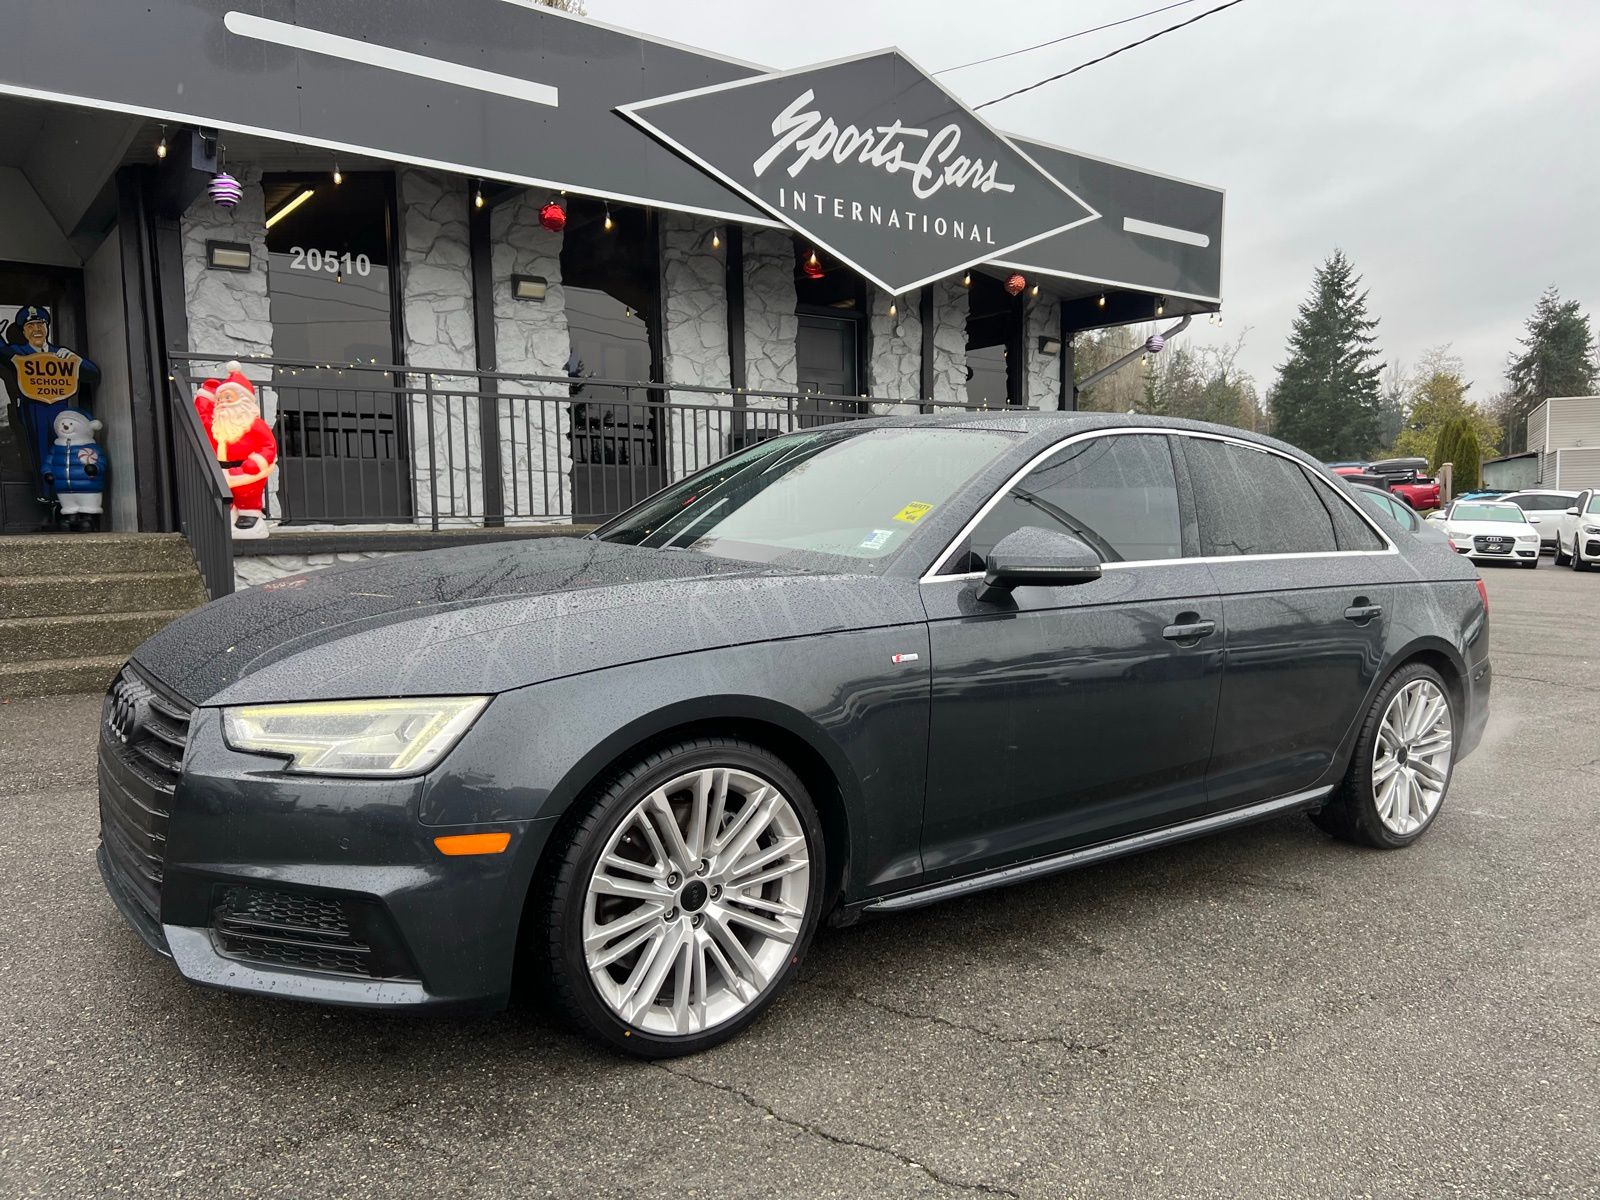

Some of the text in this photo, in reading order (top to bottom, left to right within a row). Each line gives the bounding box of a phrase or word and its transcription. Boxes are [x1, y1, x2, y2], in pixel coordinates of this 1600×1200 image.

[753, 88, 1015, 199] Sports Cars
[779, 188, 996, 245] INTERNATIONAL
[289, 246, 371, 276] 20510
[24, 360, 75, 377] SLOW
[30, 378, 72, 386] SCHOOL
[37, 387, 66, 395] ZONE
